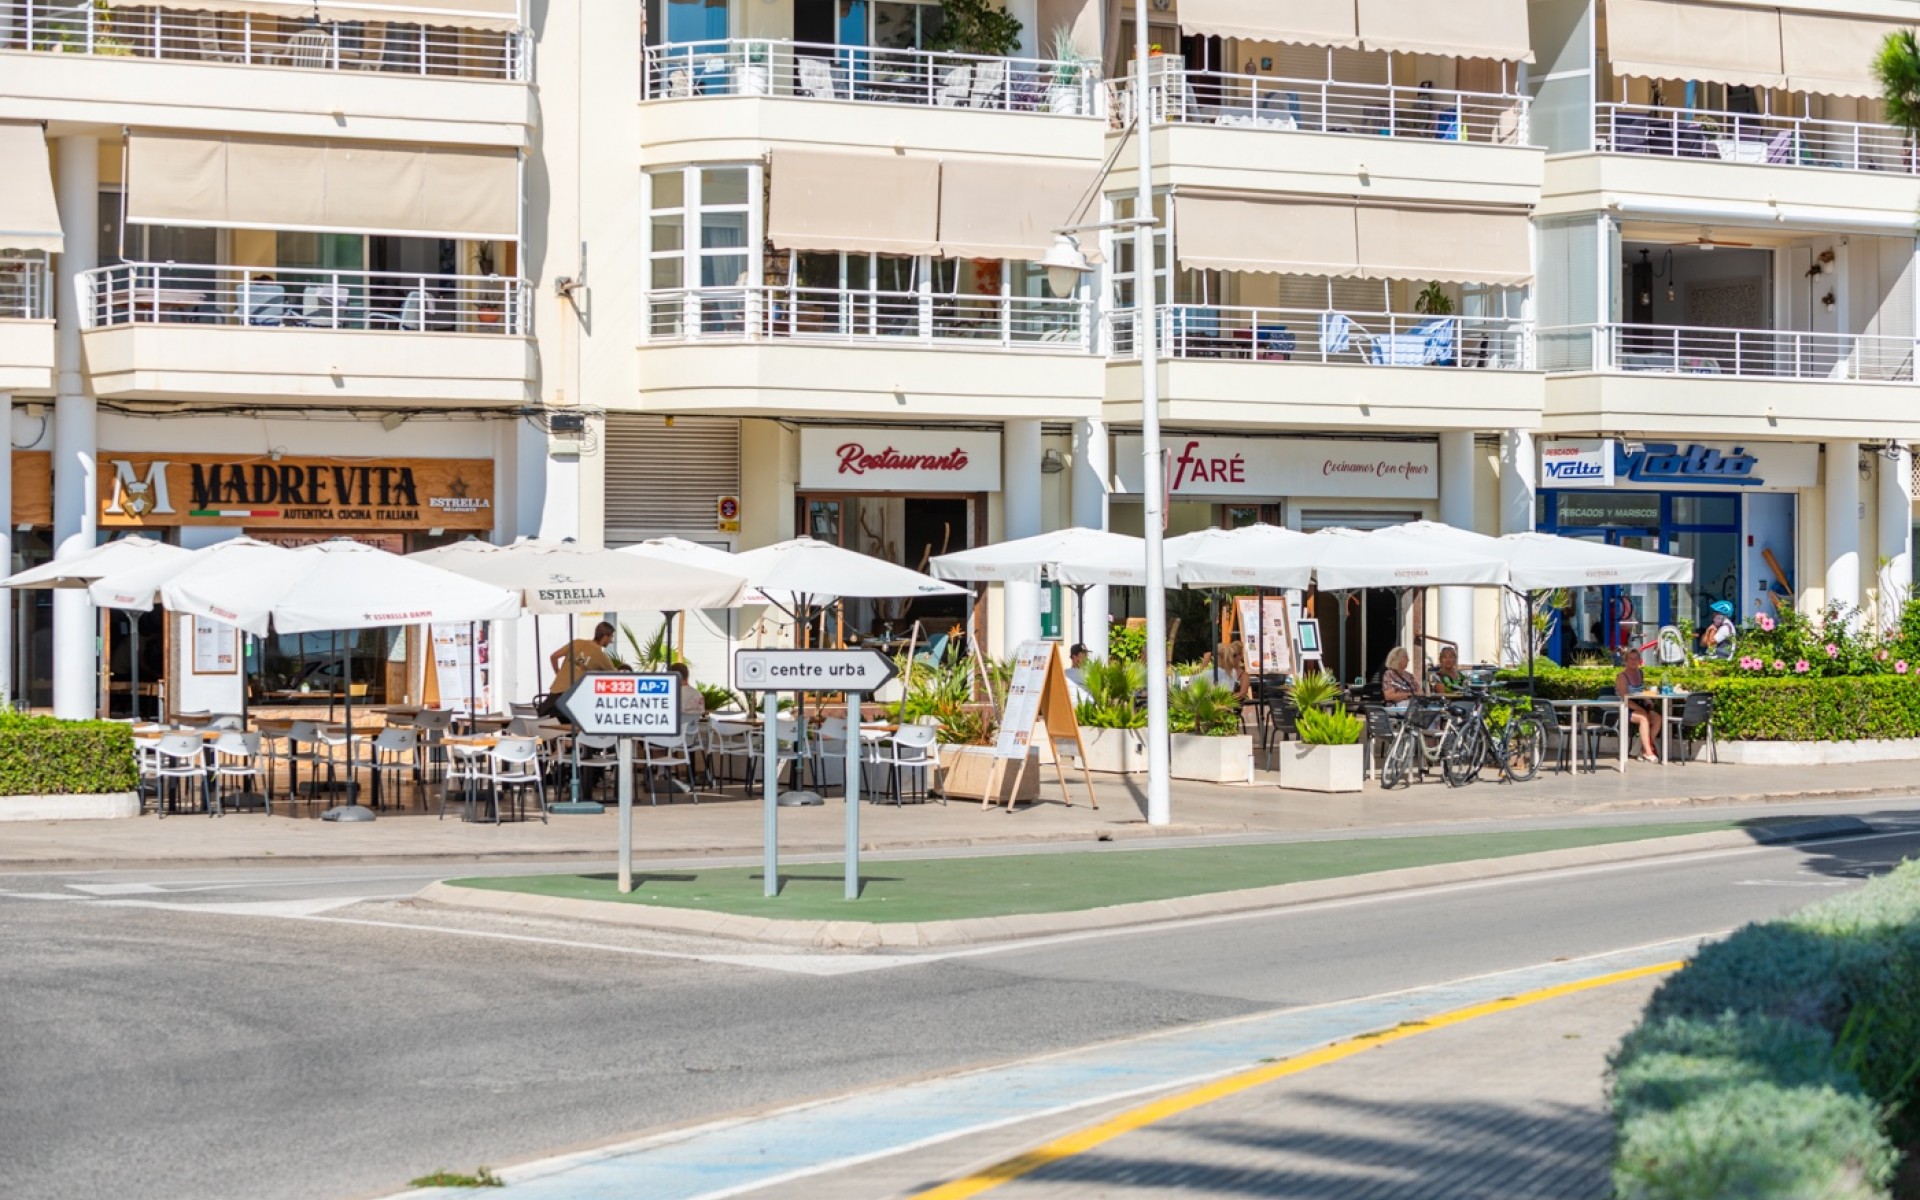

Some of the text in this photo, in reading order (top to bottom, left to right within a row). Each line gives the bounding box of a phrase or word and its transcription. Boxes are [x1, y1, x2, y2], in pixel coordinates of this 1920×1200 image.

[1546, 448, 1580, 456] PESCADOS
[836, 442, 968, 475] Restaurante
[1323, 460, 1428, 480] Cocinamos Con Amor
[190, 463, 419, 509] MADREVITA
[429, 498, 490, 508] ESTRELLA
[283, 509, 420, 521] AUTENTICA CUCINA ITALIANA
[1559, 508, 1658, 517] PESCADOS Y MARISCOS
[539, 588, 605, 600] ESTRELLA
[770, 663, 823, 676] centre
[596, 681, 633, 692] N-332
[640, 681, 666, 692] AP-7
[595, 697, 669, 709] ALICANTE
[595, 713, 669, 725] VALENCIA
